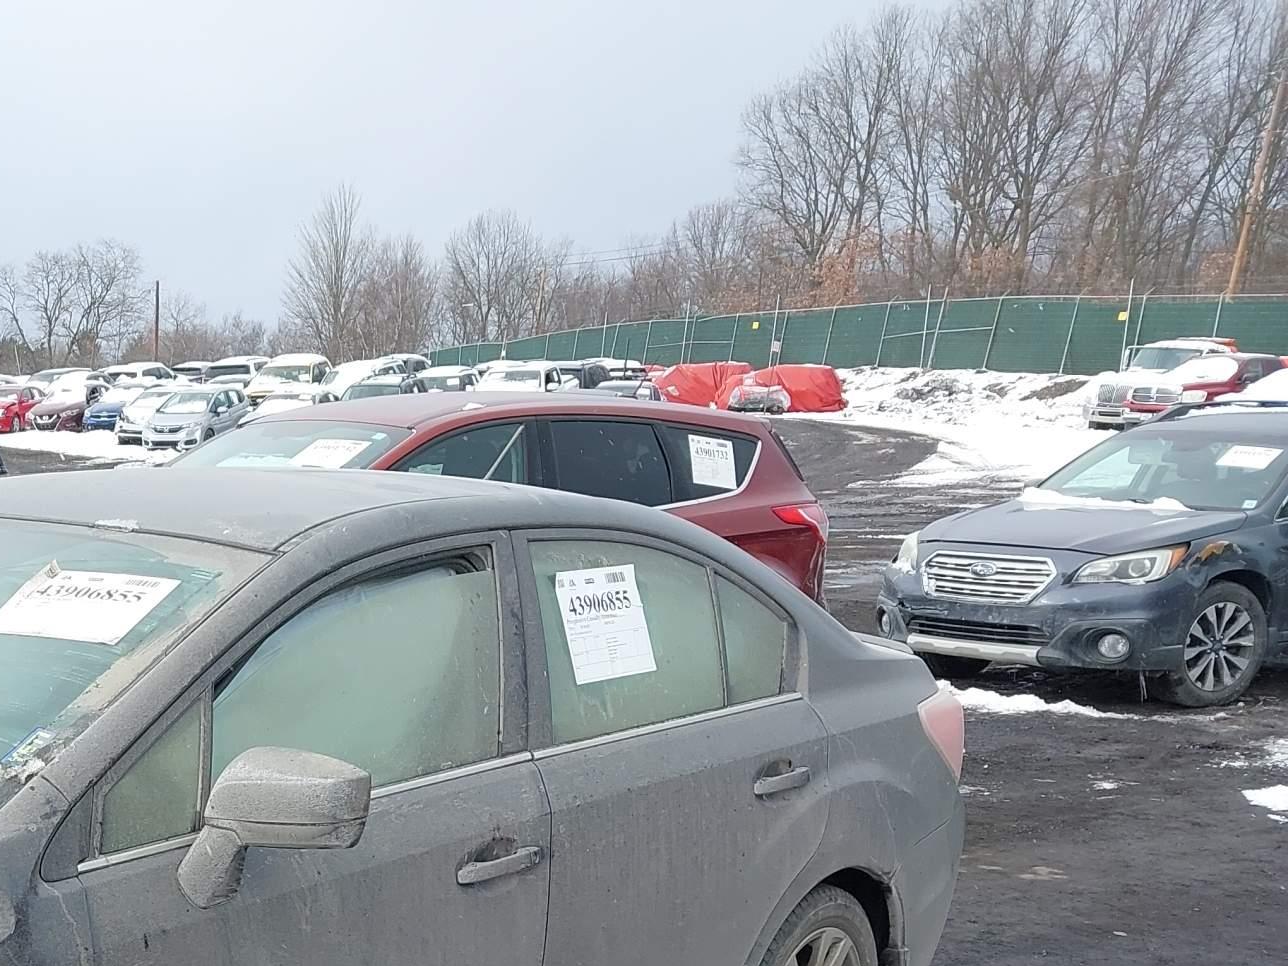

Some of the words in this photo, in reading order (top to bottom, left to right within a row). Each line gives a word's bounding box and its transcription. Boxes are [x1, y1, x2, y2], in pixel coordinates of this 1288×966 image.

[694, 446, 729, 461] 43901732
[36, 584, 147, 604] 43906855
[568, 590, 632, 616] 43906855
